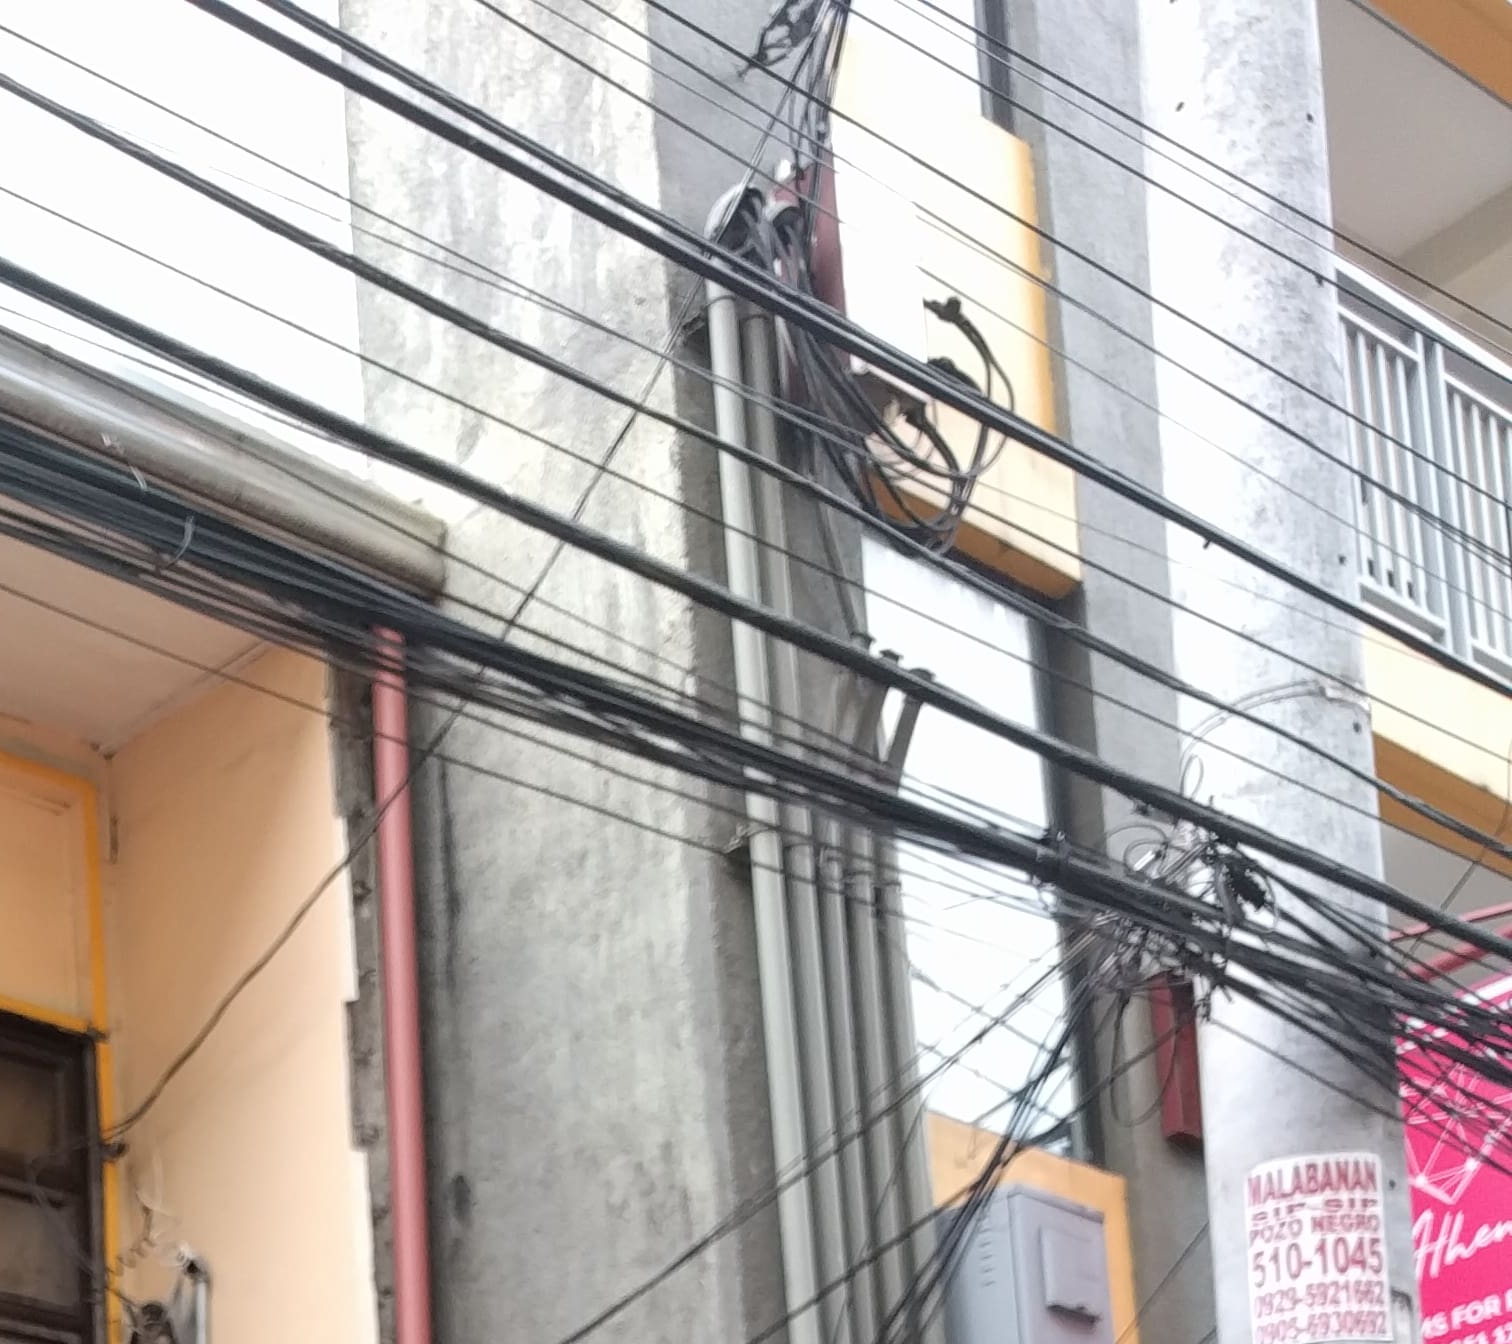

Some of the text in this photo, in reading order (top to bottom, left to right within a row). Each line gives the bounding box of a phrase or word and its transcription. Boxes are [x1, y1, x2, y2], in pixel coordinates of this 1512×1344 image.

[1311, 1214, 1380, 1233] NEGRO
[1252, 1236, 1384, 1288] 510-1045
[1451, 1293, 1503, 1331] FOR
